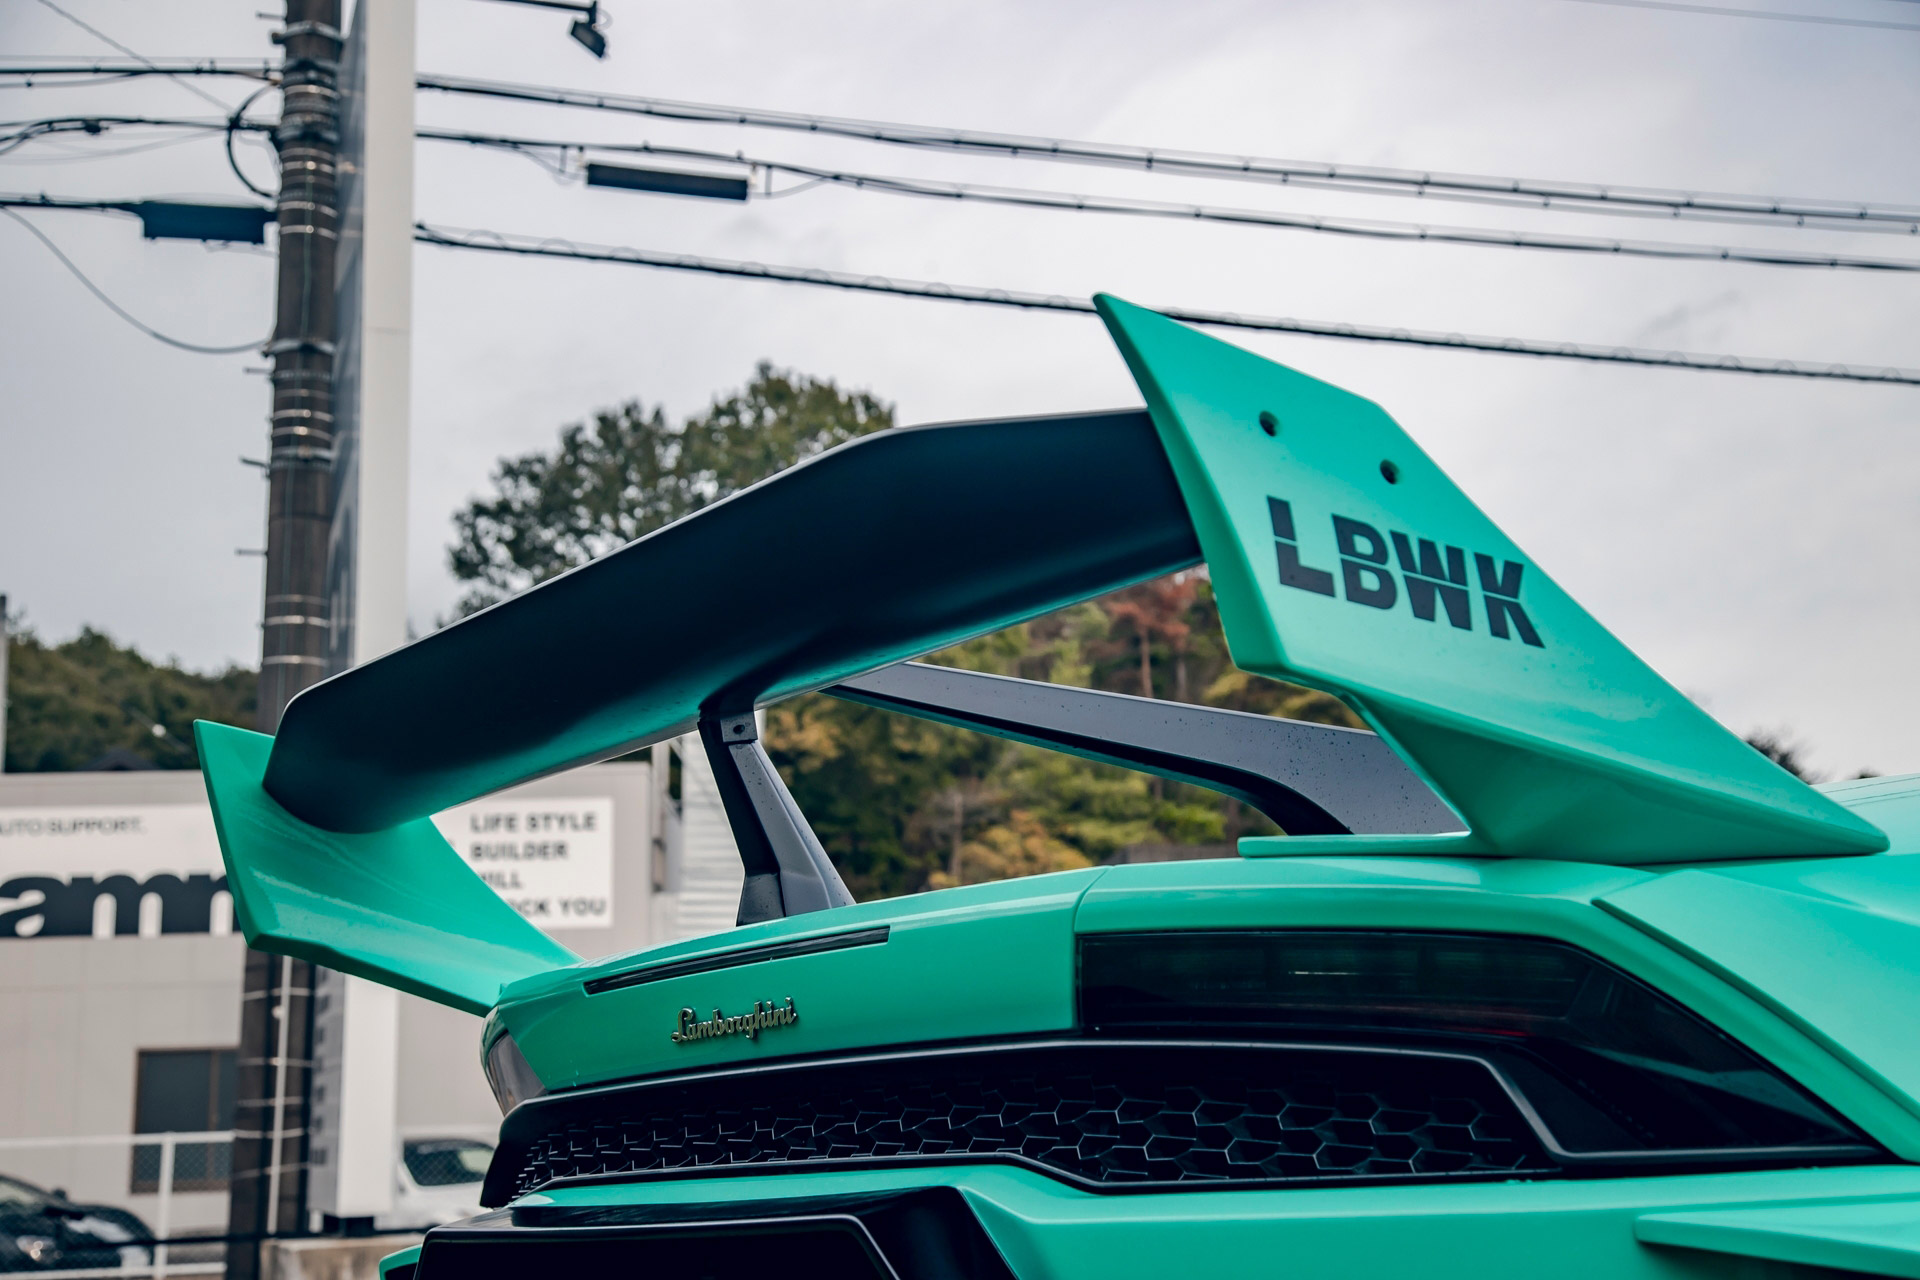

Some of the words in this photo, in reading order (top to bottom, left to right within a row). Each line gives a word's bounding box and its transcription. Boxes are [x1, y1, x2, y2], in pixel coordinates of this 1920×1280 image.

[1267, 495, 1546, 649] LBWK
[470, 813, 518, 832] LIFE
[526, 812, 597, 831] STYLE
[470, 841, 569, 861] BUILDER
[559, 899, 607, 916] YOU
[671, 996, 797, 1043] Lamborghini
